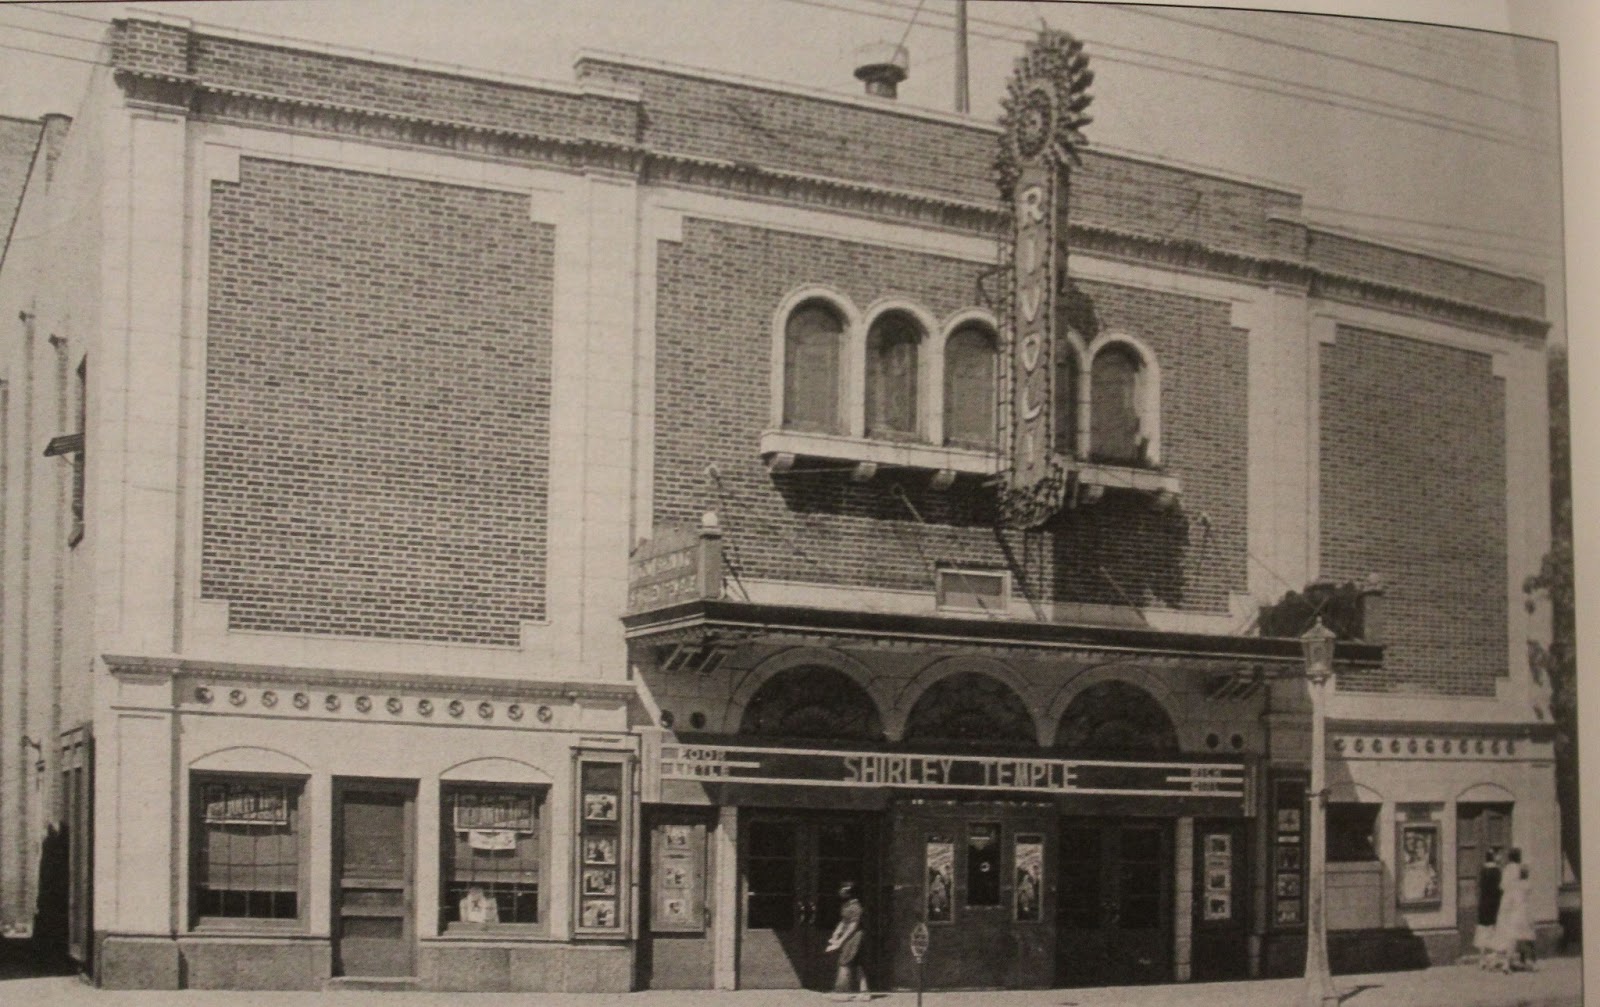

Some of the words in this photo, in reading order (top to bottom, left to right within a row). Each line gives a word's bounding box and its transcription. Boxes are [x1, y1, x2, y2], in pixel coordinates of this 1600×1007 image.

[1020, 186, 1043, 465] RIVOLI
[843, 754, 952, 786] SHIRLEY
[979, 758, 1078, 789] TEMPLE
